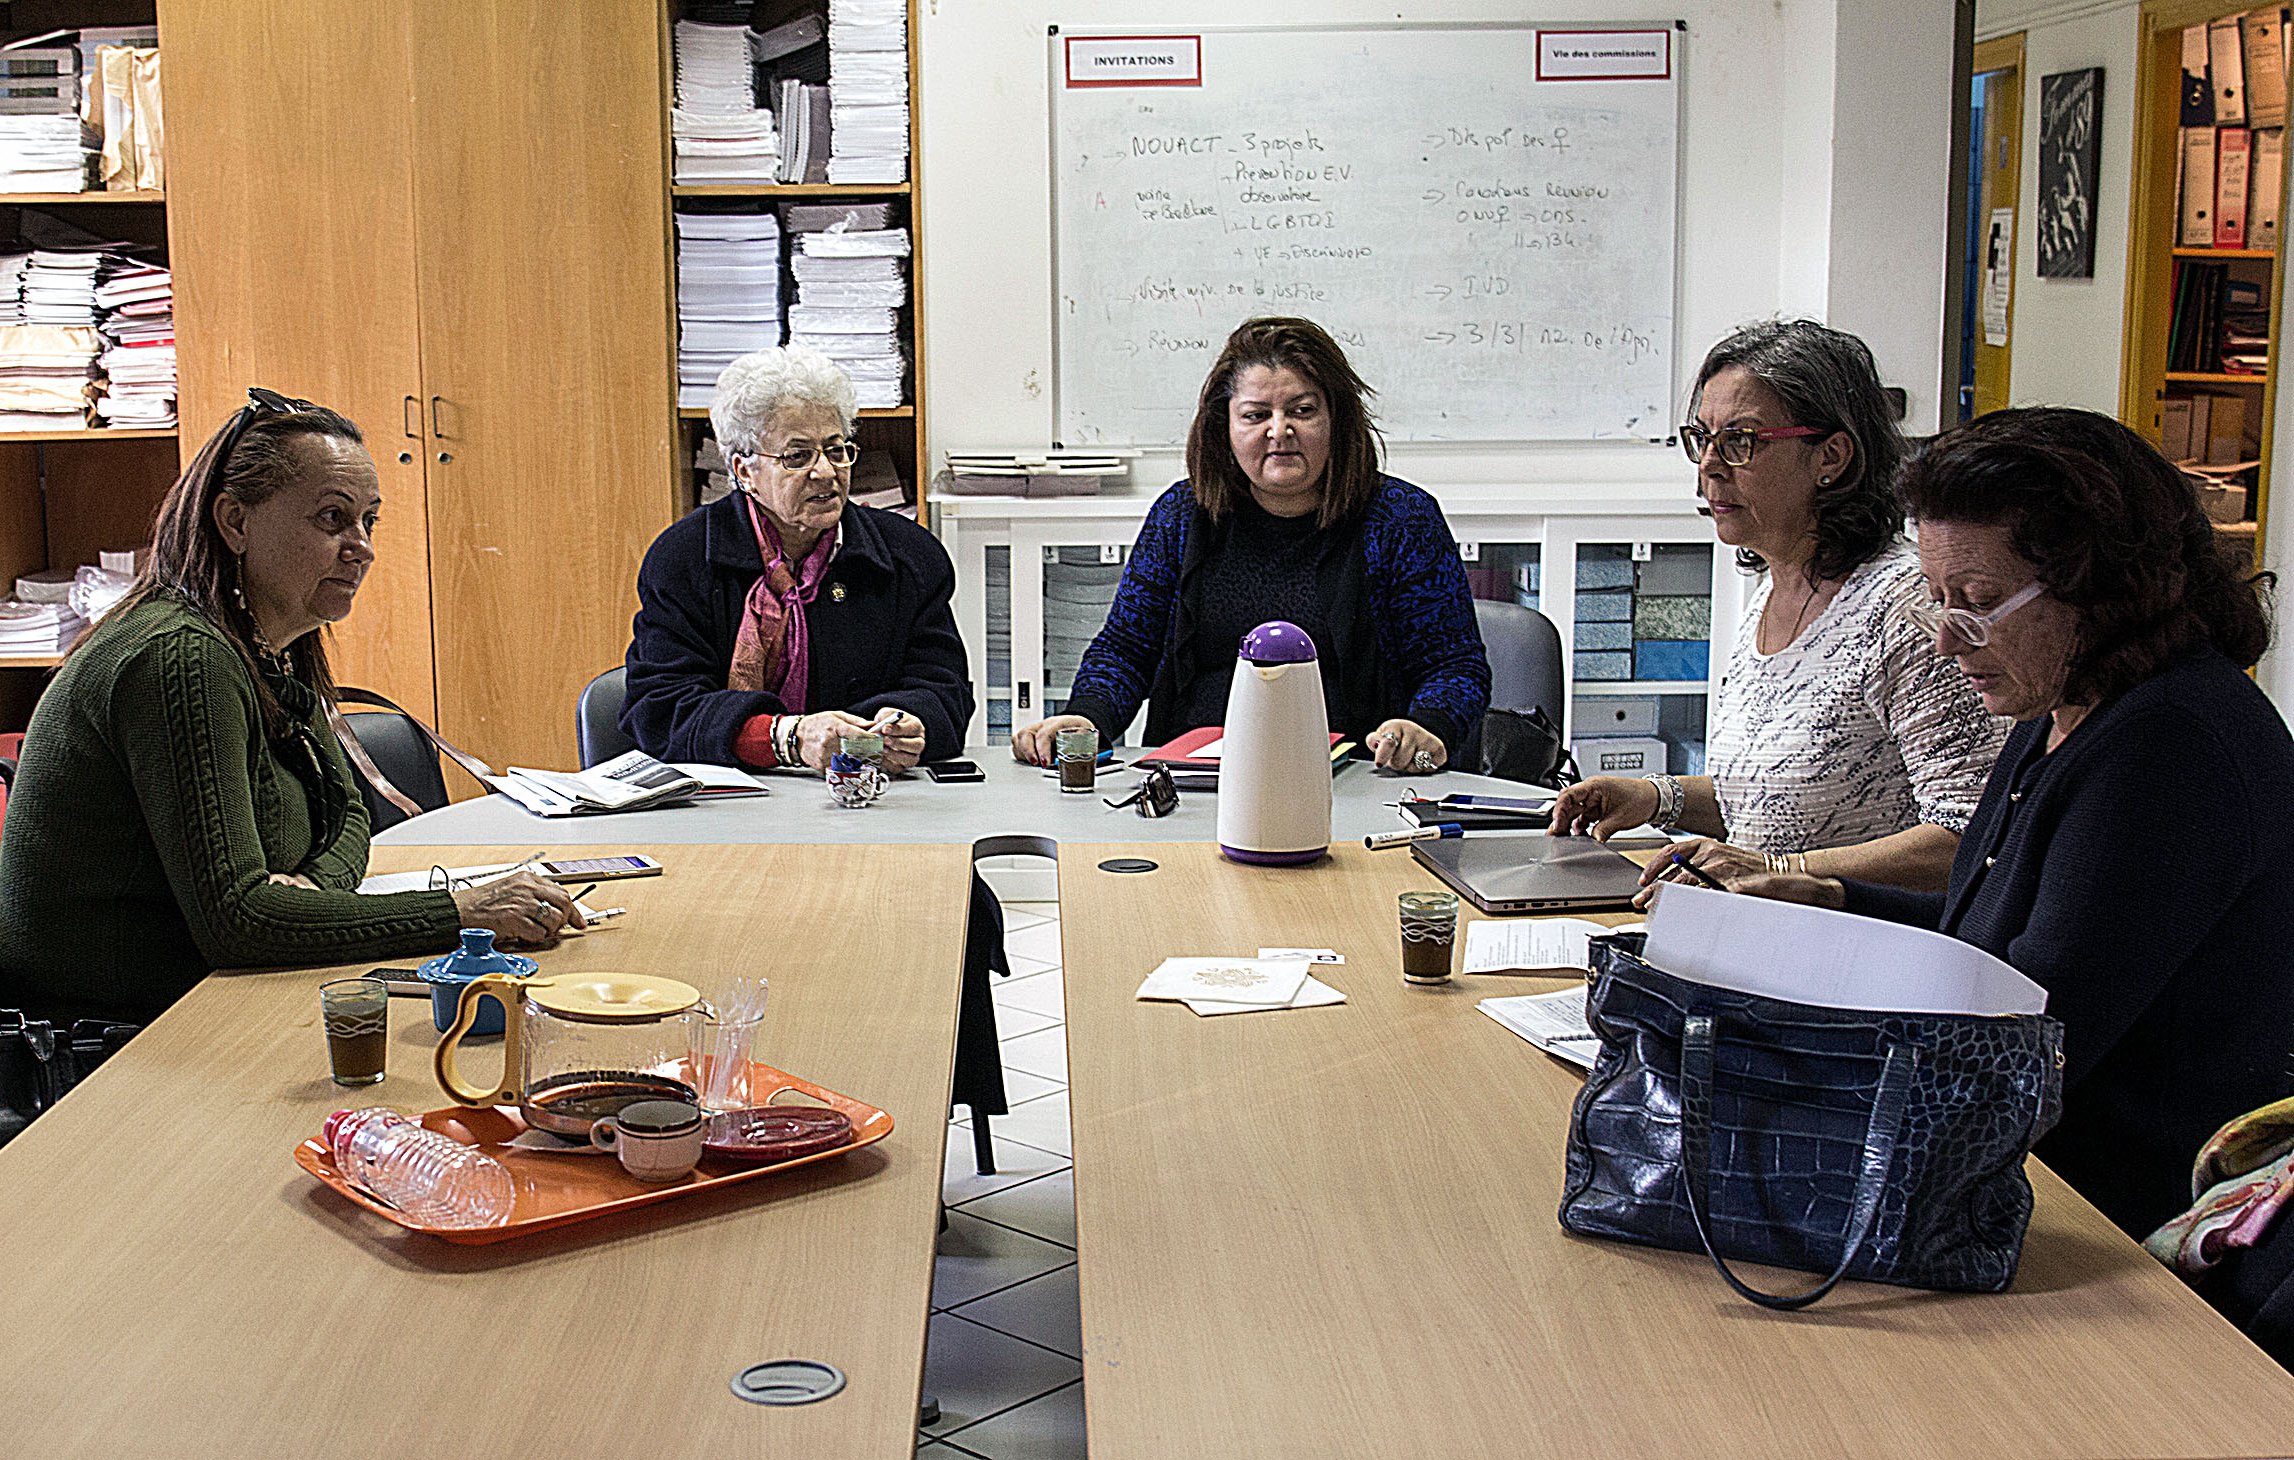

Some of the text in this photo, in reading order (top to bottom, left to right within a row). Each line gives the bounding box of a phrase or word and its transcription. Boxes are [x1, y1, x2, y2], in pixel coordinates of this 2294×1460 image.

[1553, 49, 1657, 58] Vie des commissions
[1094, 55, 1175, 67] INVITATIONS
[1242, 132, 1257, 151] 3
